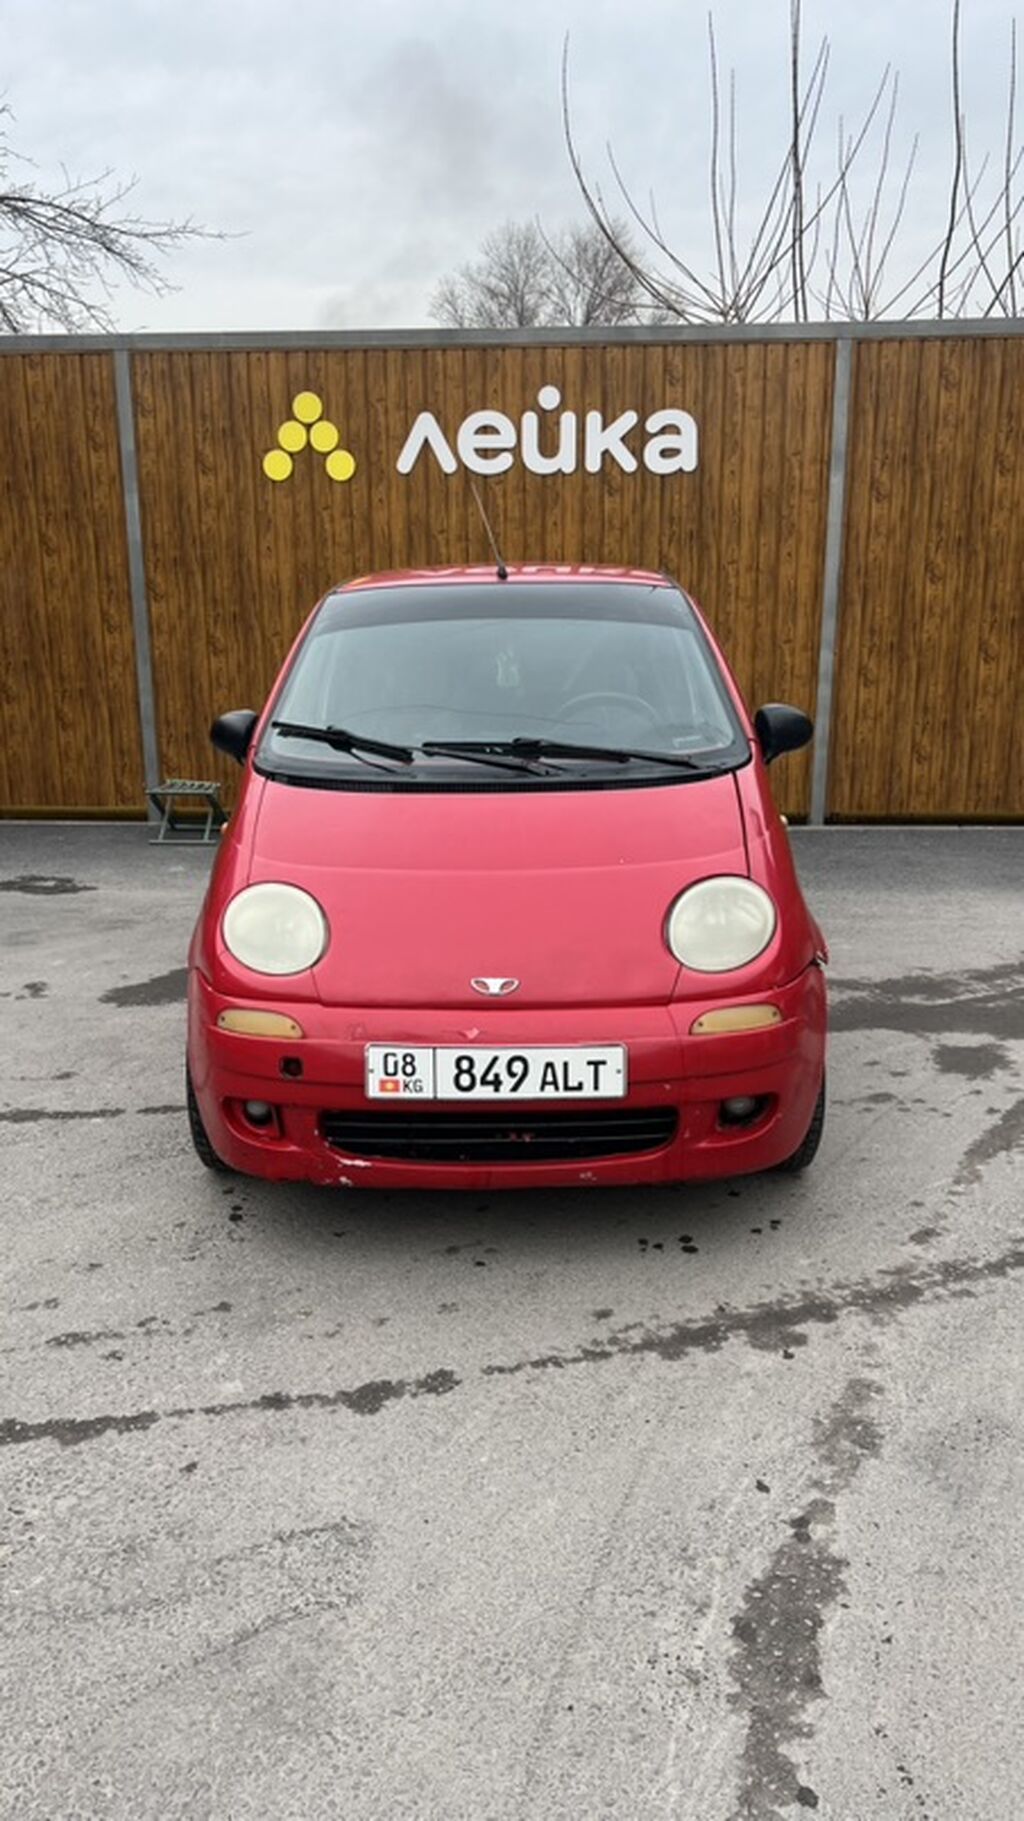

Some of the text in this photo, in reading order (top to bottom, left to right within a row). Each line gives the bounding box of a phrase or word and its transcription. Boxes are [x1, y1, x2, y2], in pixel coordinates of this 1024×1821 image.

[396, 385, 698, 475] лейка
[383, 1052, 607, 1093] 08 849 ALT
[402, 1079, 423, 1093] KG
